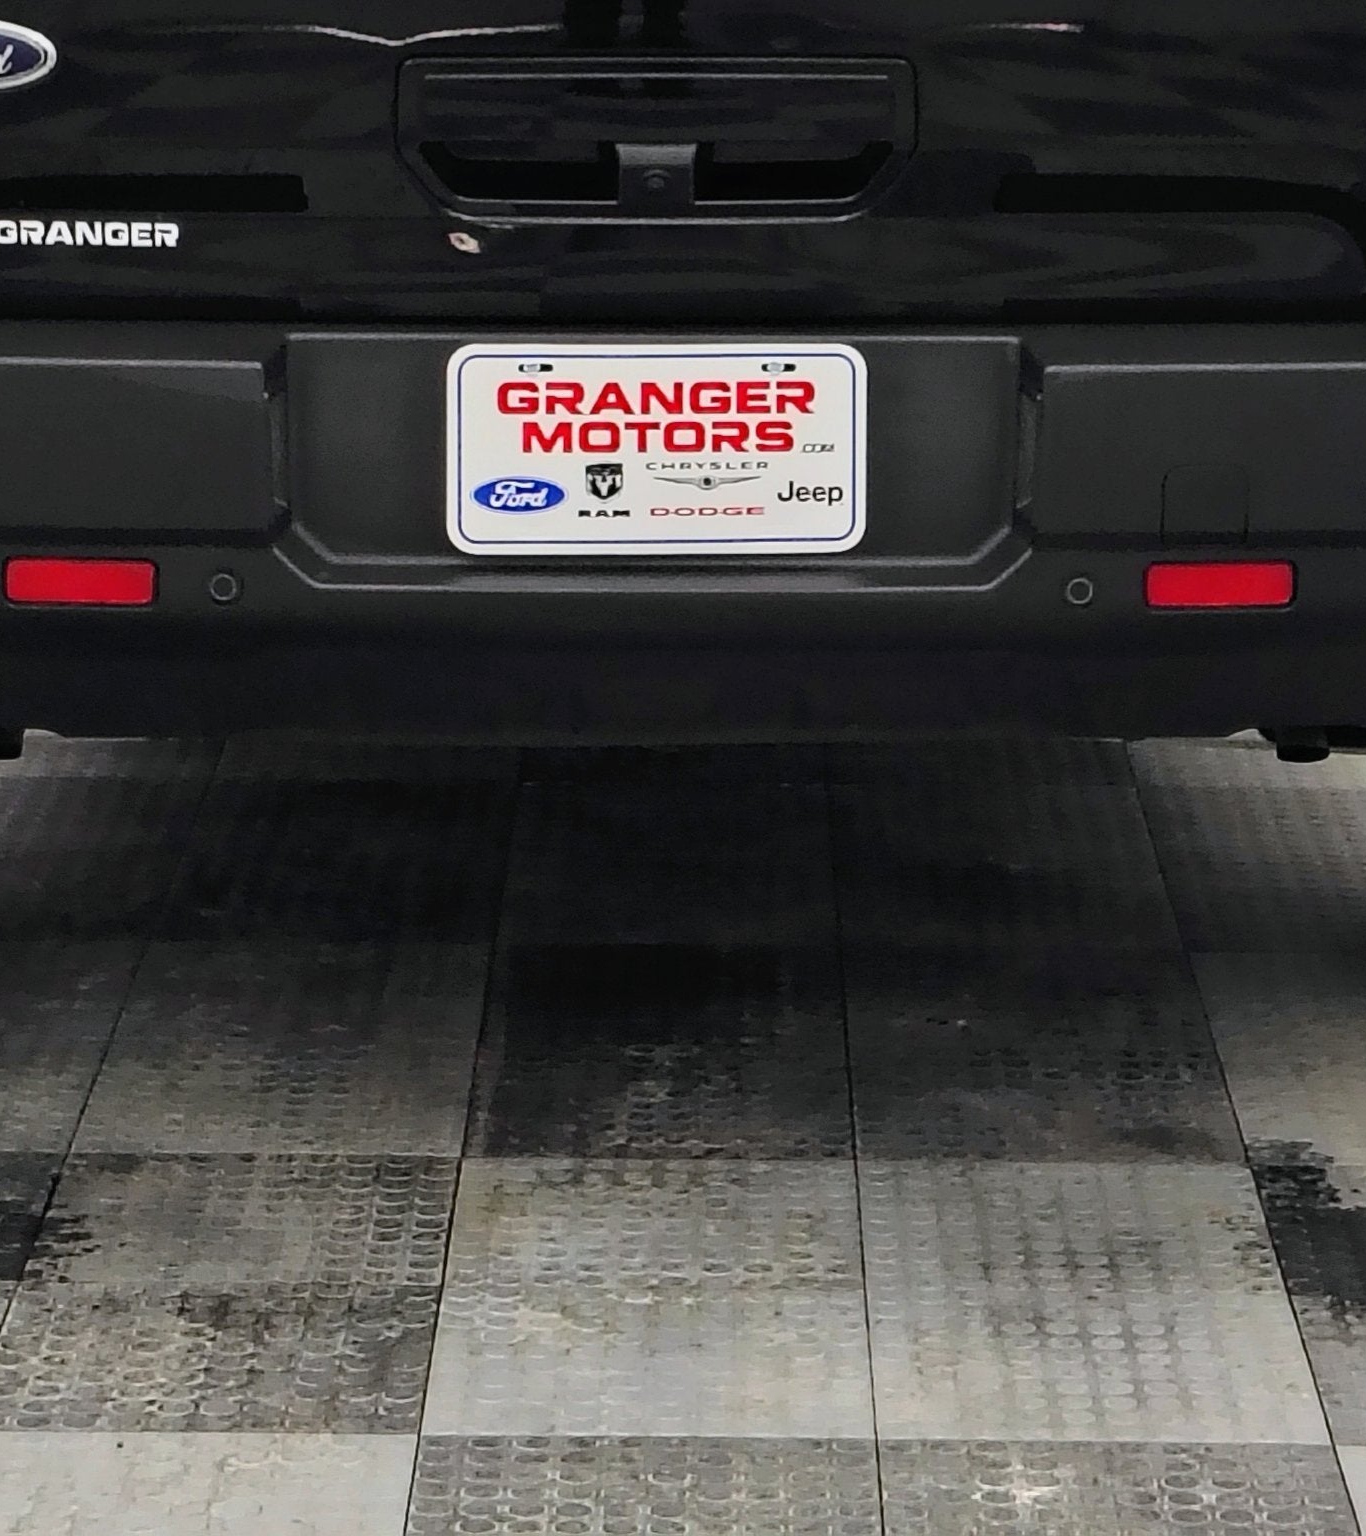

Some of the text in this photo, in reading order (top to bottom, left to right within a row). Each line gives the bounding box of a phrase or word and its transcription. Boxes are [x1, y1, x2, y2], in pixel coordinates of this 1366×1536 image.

[496, 380, 816, 415] GRANGER
[521, 420, 795, 454] MOTORS
[645, 461, 769, 471] CHRYSLER
[489, 480, 547, 508] Ford
[777, 480, 844, 506] Jeep
[577, 510, 631, 518] RAM
[649, 505, 766, 517] DODGE
